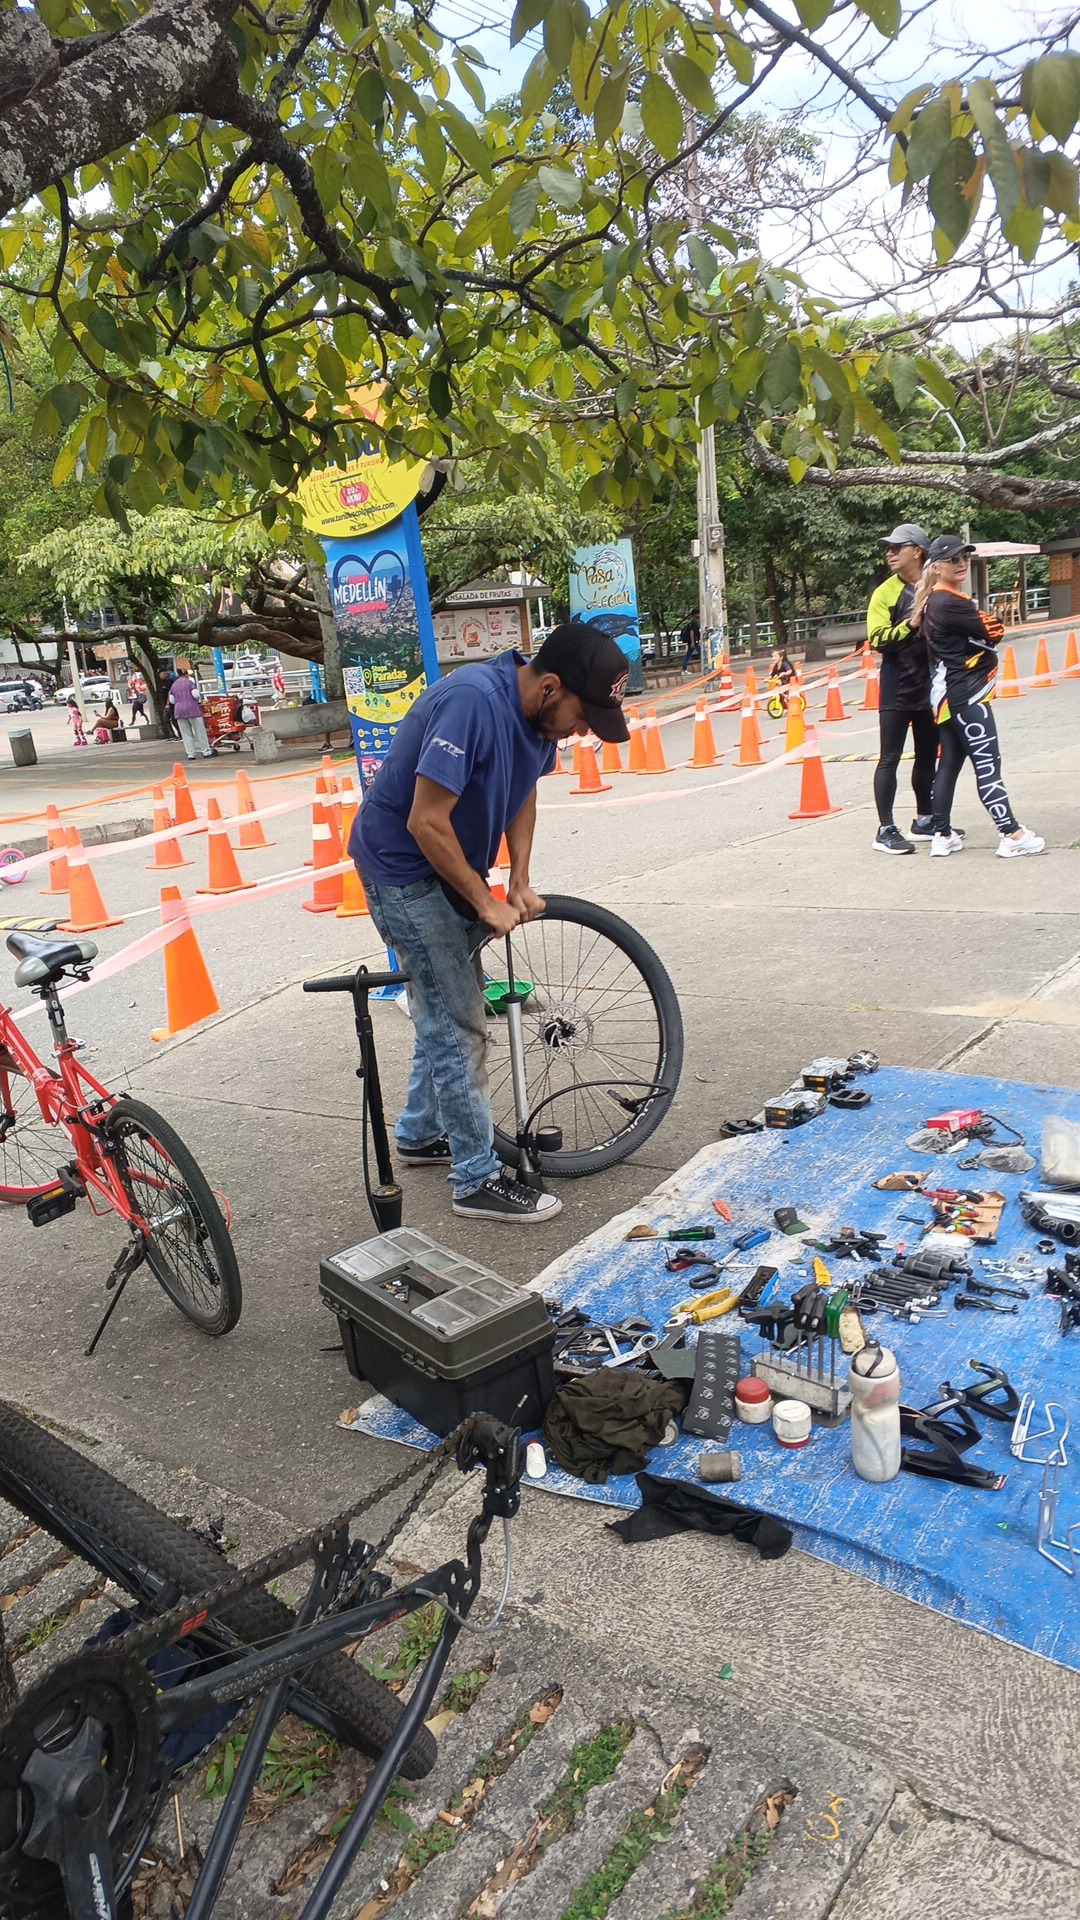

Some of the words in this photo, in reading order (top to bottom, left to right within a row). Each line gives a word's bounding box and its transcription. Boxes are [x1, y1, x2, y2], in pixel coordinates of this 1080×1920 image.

[582, 565, 615, 586] Pasa
[446, 592, 479, 601] ENSALADA
[480, 591, 488, 599] DE
[489, 590, 511, 599] FRUTAS
[373, 669, 408, 681] Paradas
